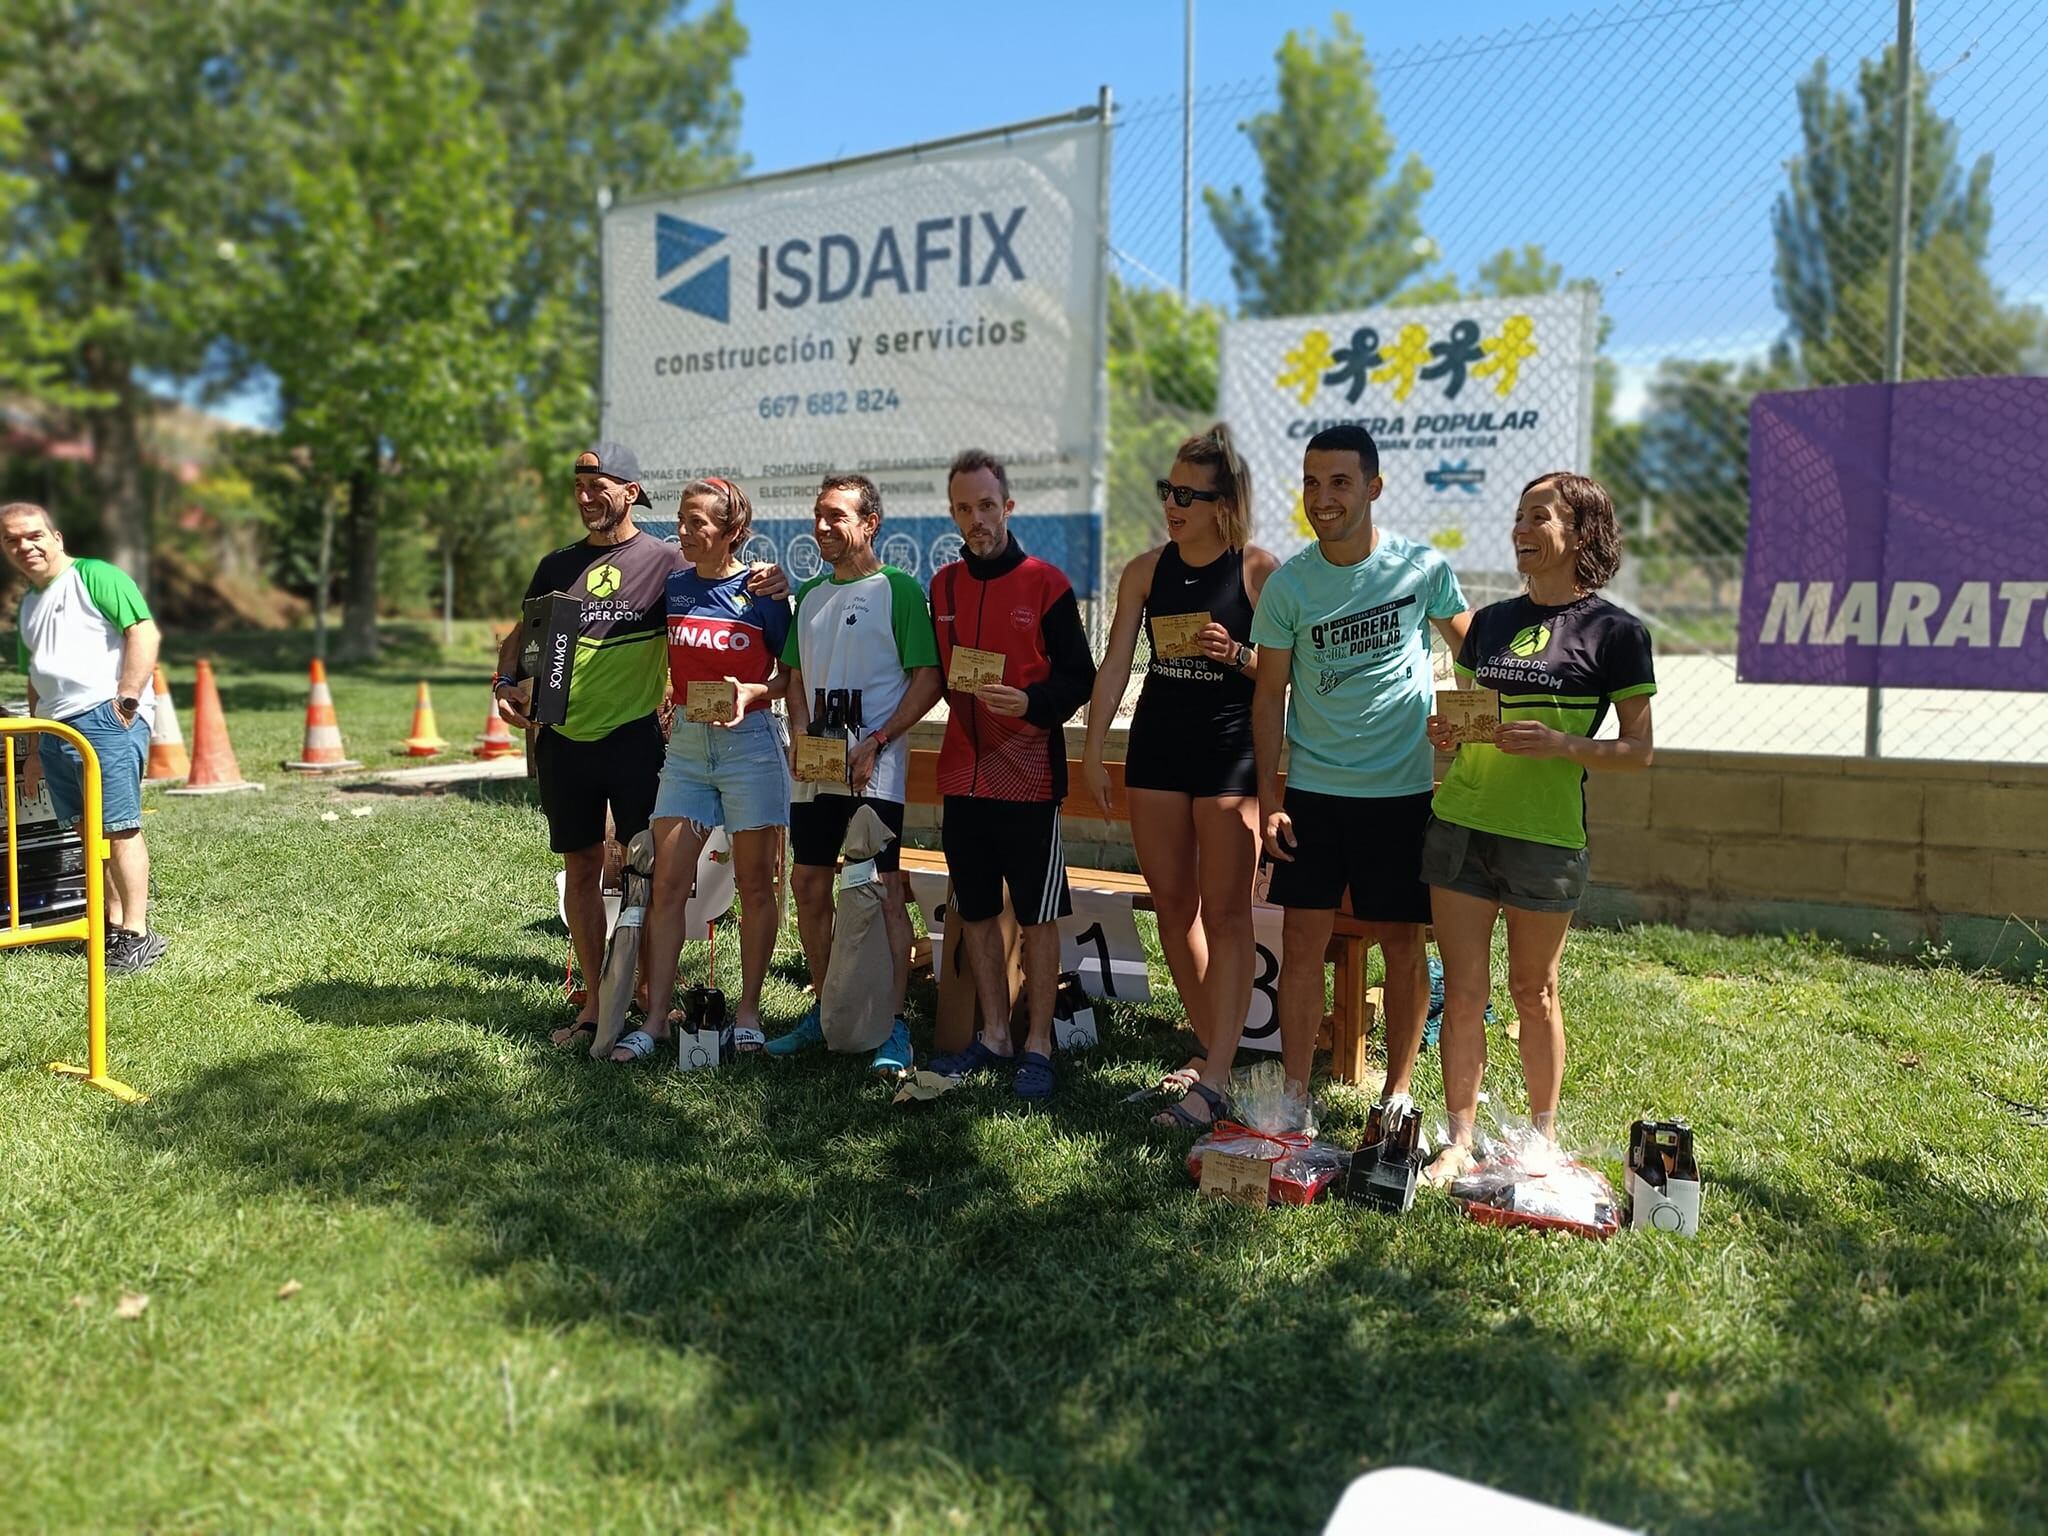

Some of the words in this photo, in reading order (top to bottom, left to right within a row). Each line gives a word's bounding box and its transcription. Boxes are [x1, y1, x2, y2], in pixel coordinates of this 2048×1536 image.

[757, 207, 1027, 311] ISDAFIX
[655, 334, 834, 376] construcción
[847, 335, 862, 366] y
[875, 317, 1027, 356] servicios
[758, 395, 799, 419] 667
[806, 391, 848, 415] 682
[855, 388, 900, 412] 824
[1412, 411, 1539, 435] POPULAR
[676, 468, 691, 480] EN
[694, 466, 744, 479] GENERAL
[615, 600, 630, 610] DE
[1759, 581, 2048, 648] MARAT
[1331, 611, 1400, 646] CARRERA
[1350, 629, 1401, 657] POPULAR
[549, 633, 568, 690] SOMMOS
[1151, 663, 1224, 682] CORRER.COM
[1168, 658, 1194, 669] RETO
[1195, 660, 1209, 671] DE
[1488, 656, 1501, 666] EL
[1501, 656, 1531, 669] RETO
[1532, 659, 1549, 671] DE
[1475, 666, 1564, 690] CORRER.COM
[1076, 922, 1118, 998] 1
